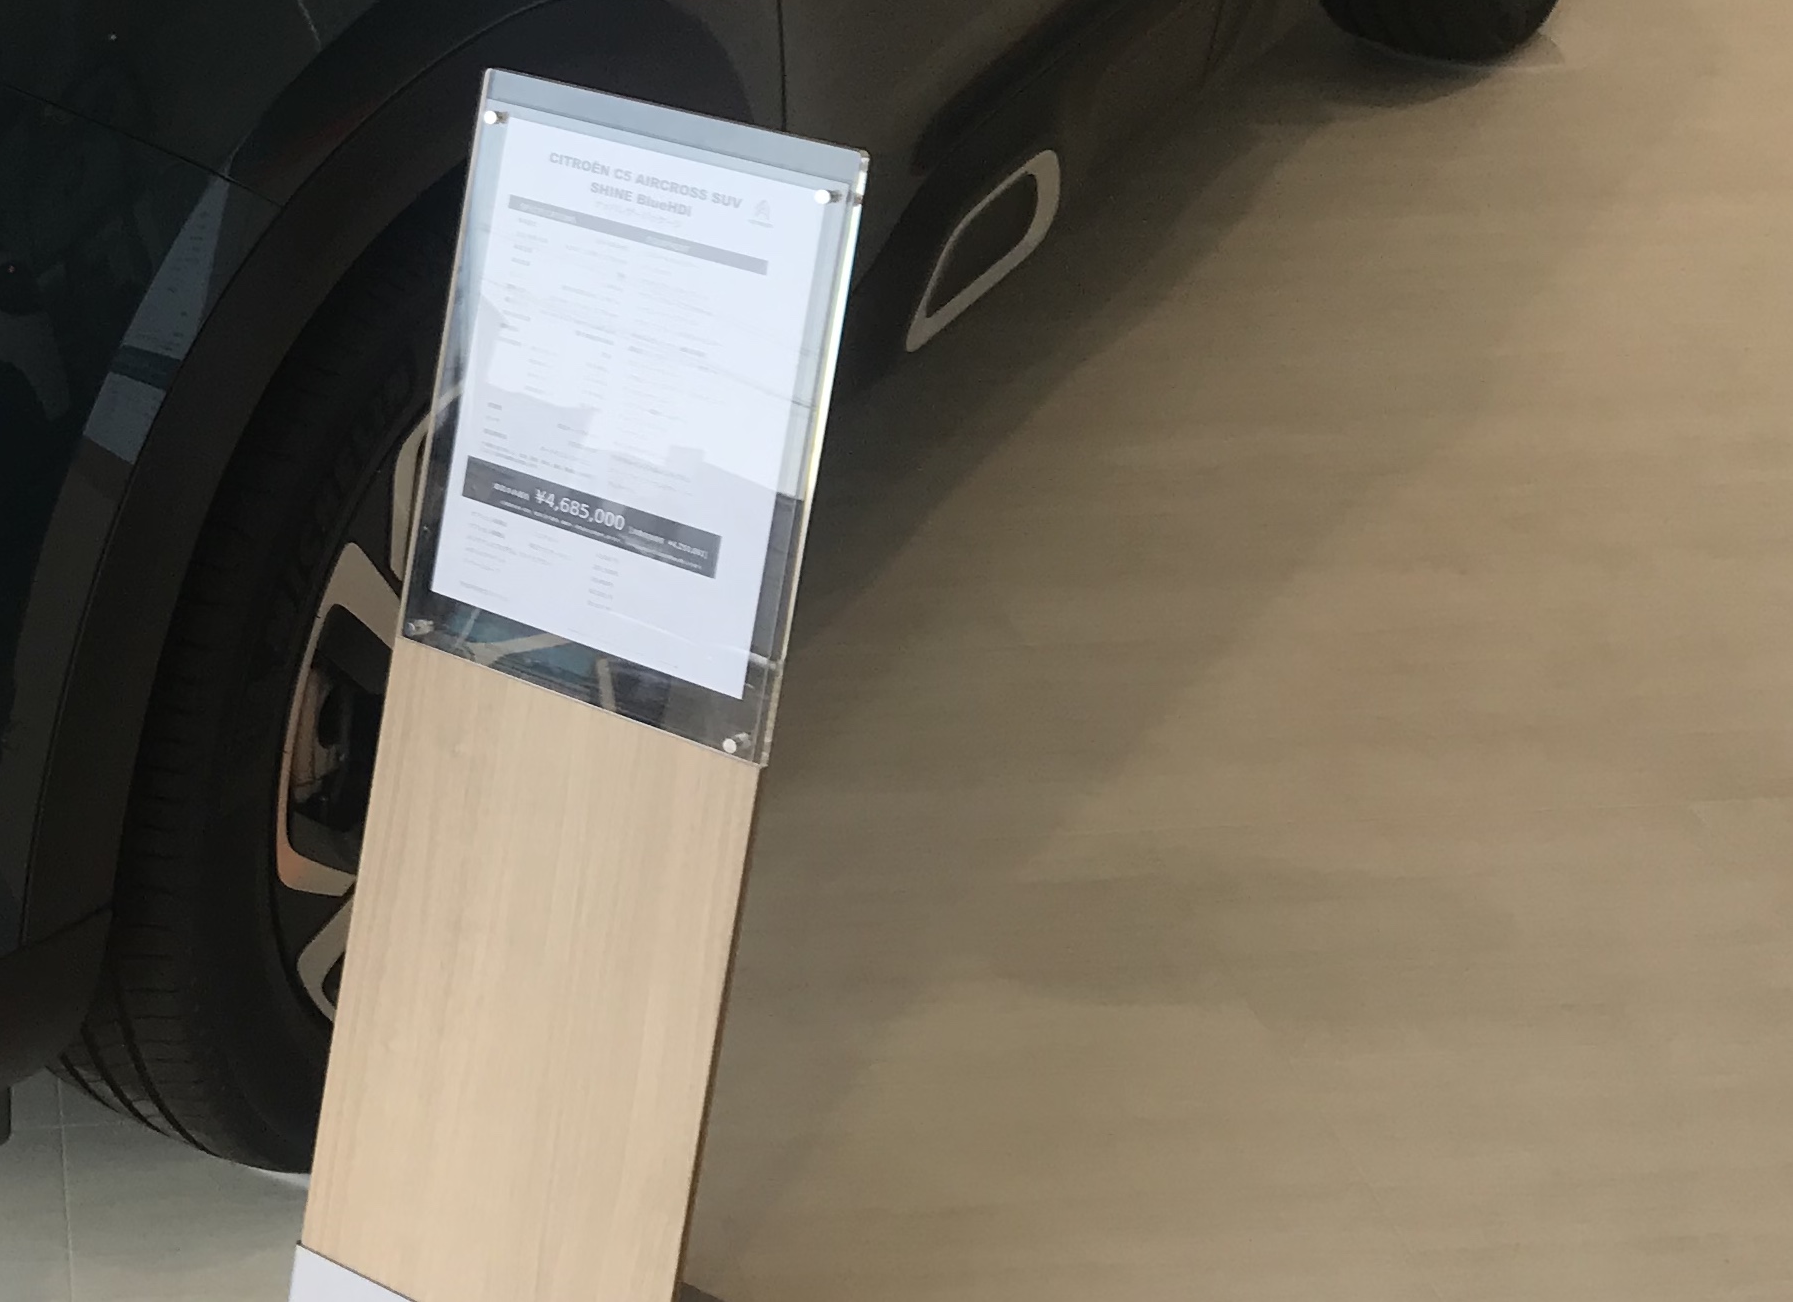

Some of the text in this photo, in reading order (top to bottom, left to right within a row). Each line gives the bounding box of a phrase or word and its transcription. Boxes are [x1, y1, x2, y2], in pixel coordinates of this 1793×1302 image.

[590, 181, 633, 202] SHINE
[636, 193, 693, 217] BlueHDi
[614, 167, 632, 182] C5
[634, 173, 708, 201] AIRCROSS
[711, 192, 744, 209] SUV
[534, 488, 626, 531] ¥4,685,000
